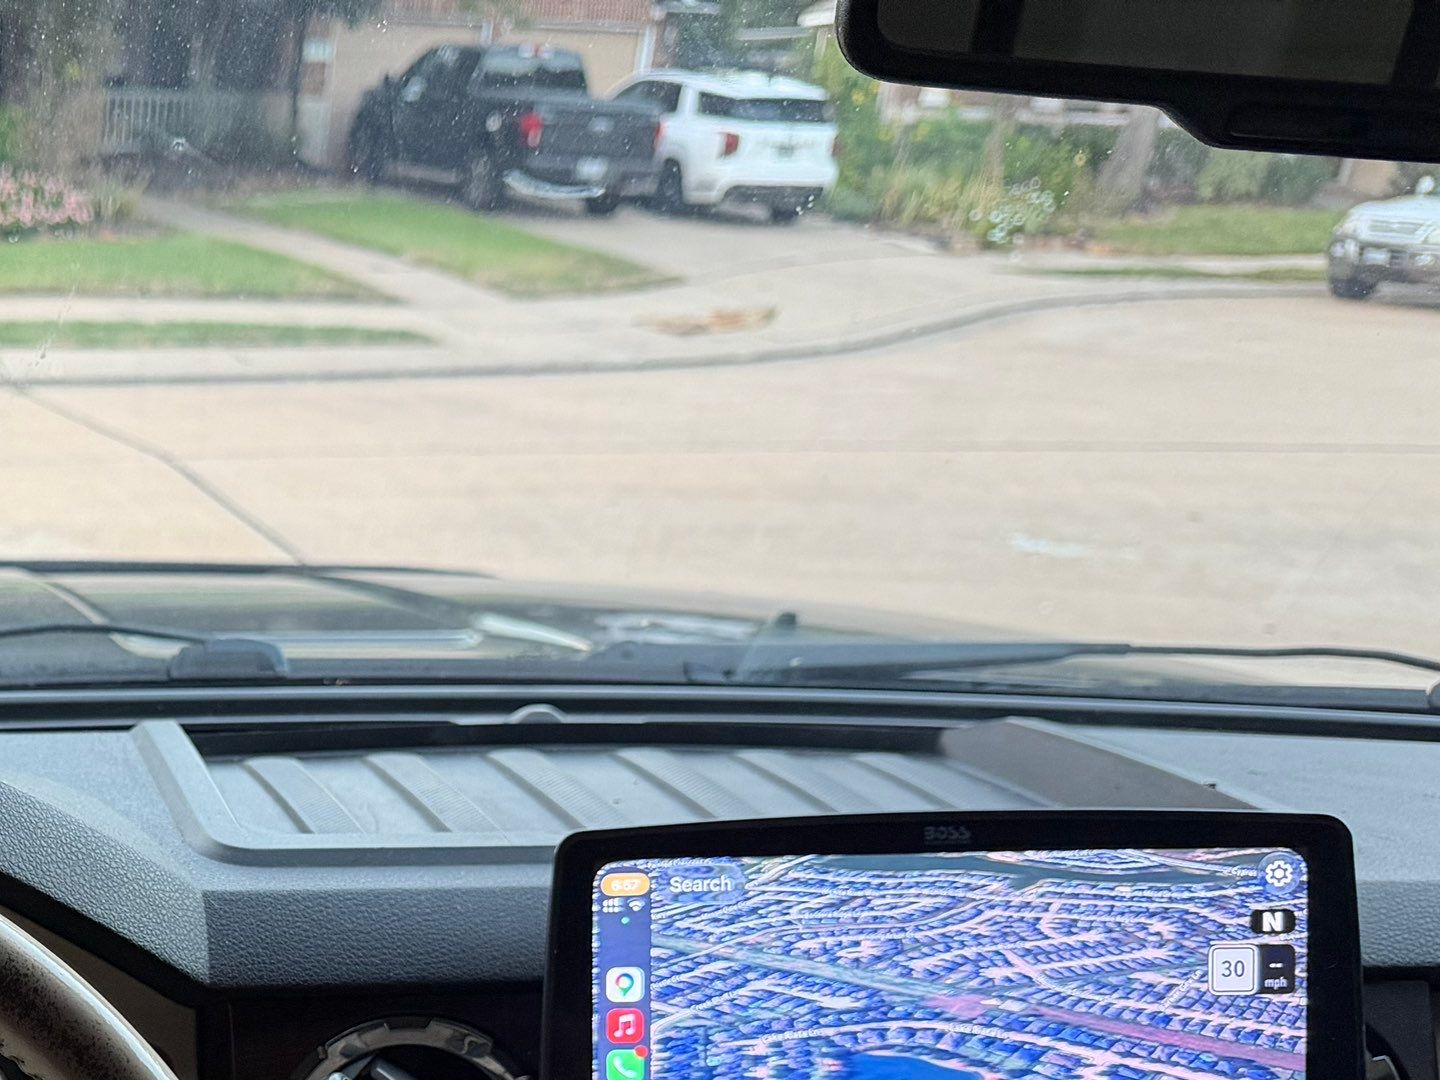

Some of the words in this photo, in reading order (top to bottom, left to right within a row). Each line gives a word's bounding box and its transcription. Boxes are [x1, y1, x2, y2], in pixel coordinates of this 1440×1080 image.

[669, 874, 732, 894] Search
[1261, 912, 1284, 932] N
[1221, 960, 1246, 978] 30
[1264, 976, 1288, 990] mph
